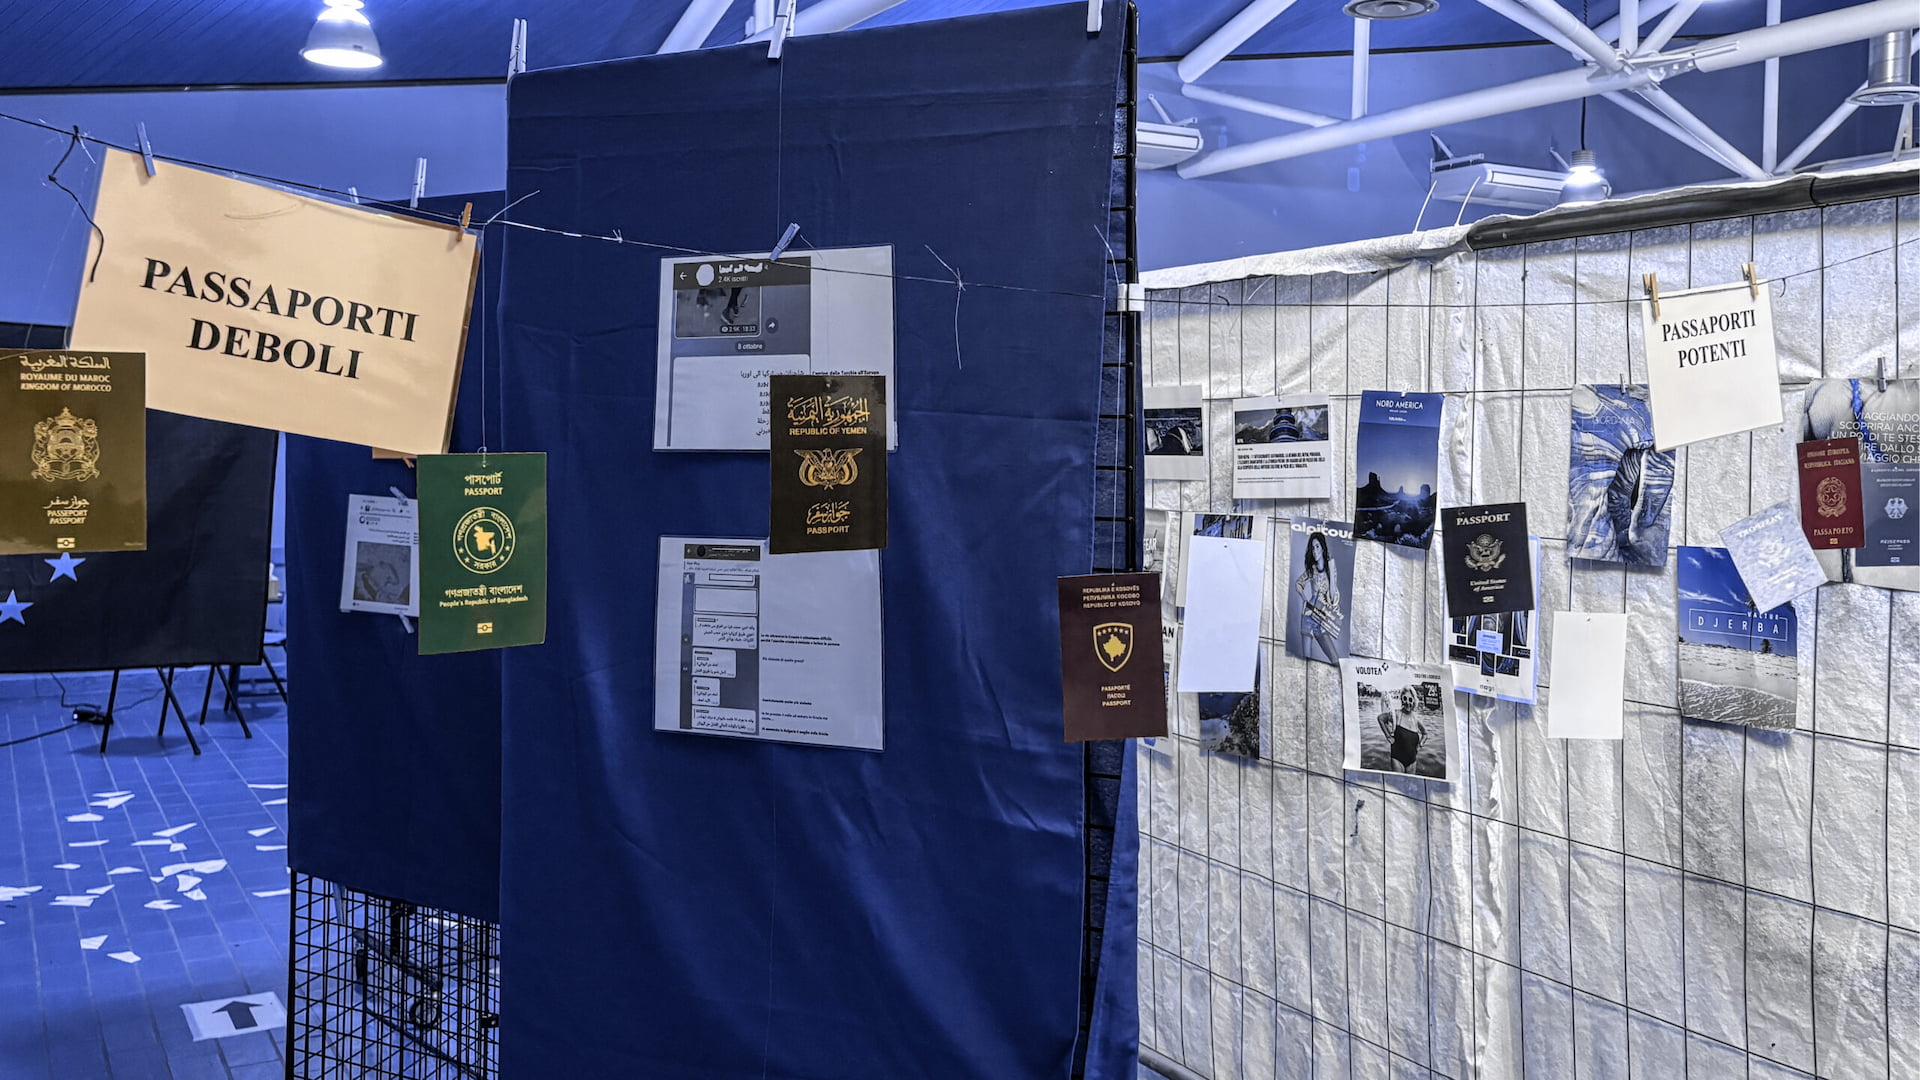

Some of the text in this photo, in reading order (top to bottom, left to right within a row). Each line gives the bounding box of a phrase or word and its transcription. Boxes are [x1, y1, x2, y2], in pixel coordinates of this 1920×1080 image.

[139, 257, 420, 342] PASSAPORTI
[1662, 310, 1756, 342] PASSAPORTI
[186, 317, 364, 380] DEBOLI
[1678, 339, 1747, 368] POTENTI
[20, 373, 110, 383] ROYAUME DU MAROC
[20, 383, 60, 391] KINGDOM
[72, 384, 112, 393] MOROCCO
[1375, 400, 1424, 410] NORD AMERICA
[1854, 412, 1920, 422] VIAGGIANDO
[1839, 421, 1894, 431] SCOPRIRAI
[789, 427, 868, 436] REPUBLIC OF YEMEN
[1869, 432, 1880, 441] DI
[1882, 433, 1895, 442] TE
[1880, 443, 1914, 453] DALLO
[464, 487, 503, 496] PASSPORT
[47, 509, 88, 517] PASSEPORT
[49, 517, 86, 525] PASSPORT
[1456, 512, 1511, 526] PASSPORT
[807, 526, 850, 535] PASSPORT
[1813, 527, 1854, 536] PASSAPORTO
[439, 600, 464, 608] People's
[465, 598, 489, 606] Republic
[497, 596, 529, 605] Bangladesh
[1082, 601, 1109, 609] REPUBLIC
[1698, 616, 1780, 635] DJERBA
[1356, 666, 1382, 676] VOLOTEA
[1102, 699, 1132, 708] PASSPORT
